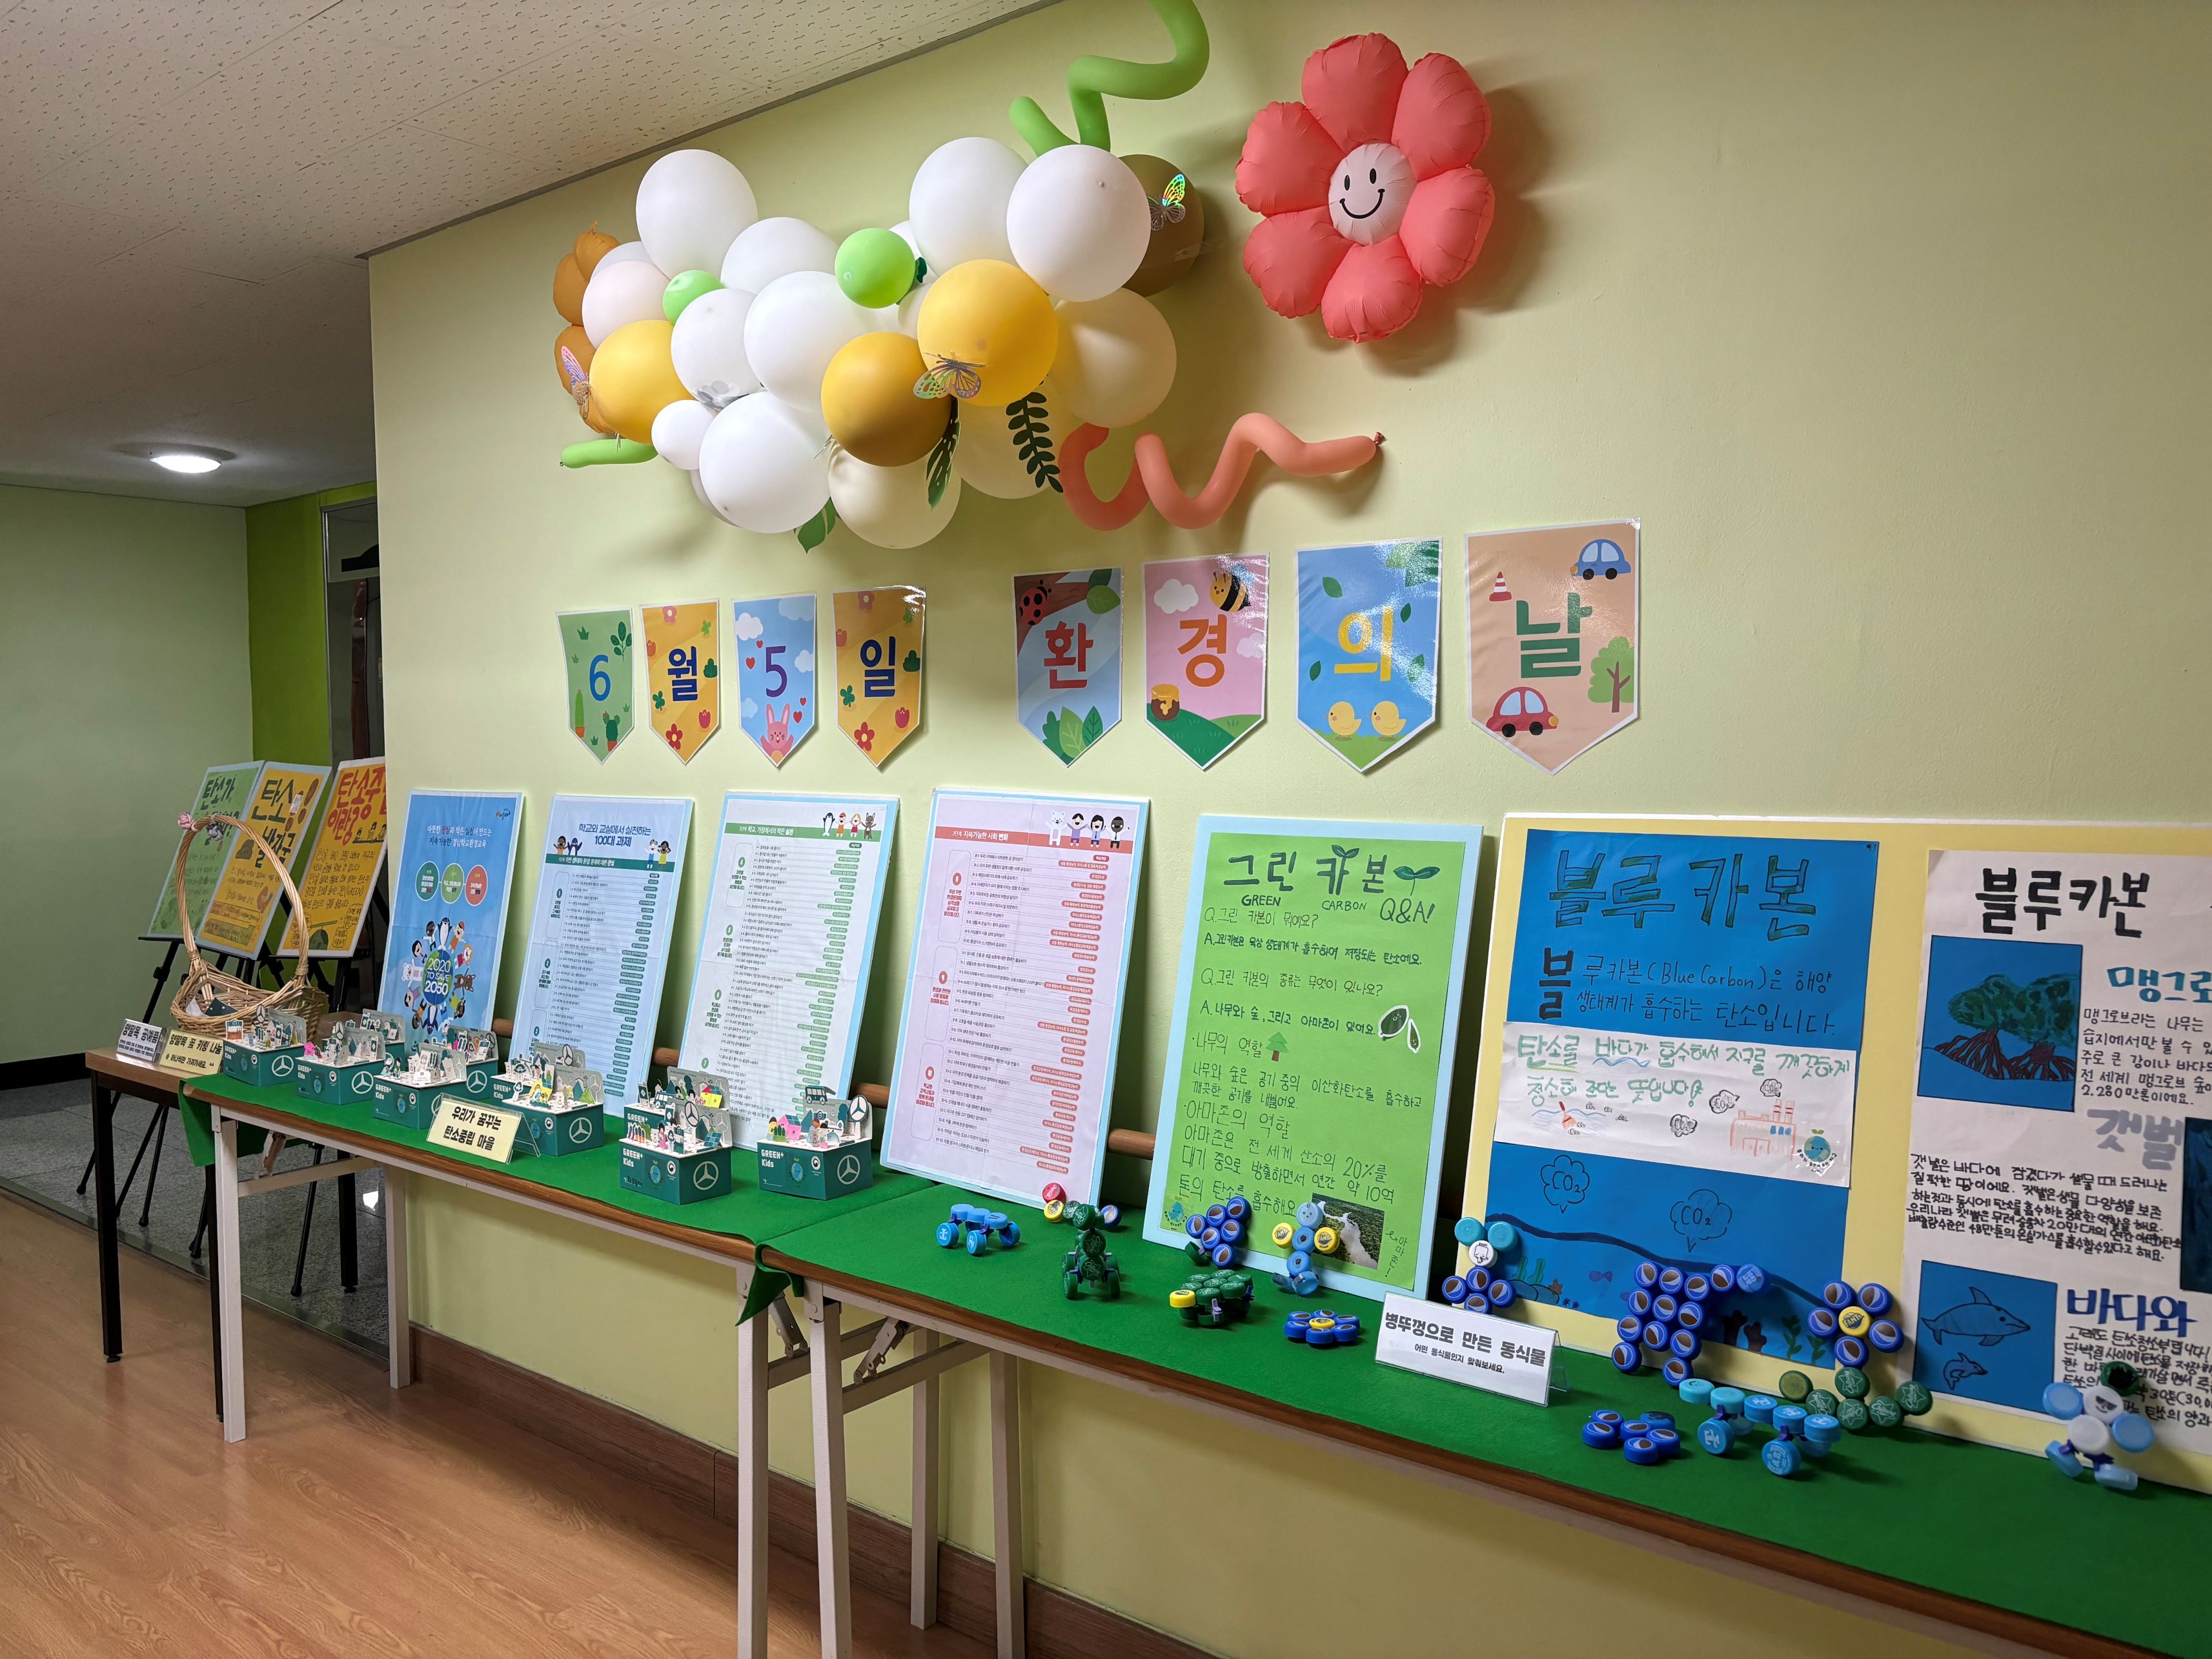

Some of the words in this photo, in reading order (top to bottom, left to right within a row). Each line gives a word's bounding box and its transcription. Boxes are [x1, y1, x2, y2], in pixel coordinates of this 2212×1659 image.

[1516, 593, 1593, 678] 날
[251, 779, 294, 824] 탄소
[337, 766, 387, 820] 탄소중
[579, 823, 598, 833] 학교와
[599, 825, 624, 835] 교실에서
[625, 826, 651, 835] 실천하는
[595, 835, 615, 846] 100대
[616, 837, 632, 847] 과제
[1224, 851, 1297, 891] 그린
[1316, 846, 1388, 895] 카본
[1241, 895, 1281, 906] GREEN
[1322, 901, 1367, 911] CARBON
[1380, 898, 1435, 924] Q&A!
[1248, 911, 1275, 926] 카본이
[1250, 937, 1263, 948] 육상
[1266, 939, 1299, 952] 생태계가
[1302, 942, 1338, 960] 흡수하여
[1345, 948, 1376, 962] 저장되는
[427, 958, 451, 973] 2020
[436, 973, 449, 981] SAVE
[425, 981, 448, 995] 2050
[1243, 971, 1268, 988] 카본의
[1280, 973, 1301, 988] 종류는
[1309, 975, 1337, 991] 무엇이
[1344, 981, 1383, 996] 있나요?
[1796, 971, 1832, 993] 해양
[1577, 989, 1634, 1013] 생태계가
[1641, 993, 1703, 1022] 흡수하는
[1717, 1003, 1835, 1035] 탄소입니다.
[2084, 1009, 2155, 1028] 맹그로브라는
[2167, 1017, 2203, 1032] 나무는
[1301, 1015, 1339, 1030] 아마존이
[1346, 1021, 1375, 1035] 있어요.
[196, 1040, 210, 1052] 키링
[210, 1043, 222, 1055] 나눔
[1239, 1038, 1263, 1058] 역할
[1517, 1034, 1580, 1068] 탄소를
[1596, 1037, 1648, 1057] 바다가
[1658, 1041, 1719, 1068] 흡수해서
[1725, 1047, 1766, 1077] 지구를
[1776, 1053, 1850, 1079] 깨끗하게
[2162, 1037, 2172, 1054] 볼
[2181, 1041, 2192, 1053] 수
[2081, 1050, 2105, 1065] 주로
[2111, 1052, 2121, 1066] 큰
[2130, 1055, 2171, 1068] 강이나
[1193, 1061, 1221, 1081] 나무와
[1230, 1066, 1247, 1084] 숲은
[1259, 1072, 1275, 1087] 공기
[1280, 1074, 1300, 1092] 중의
[1312, 1079, 1374, 1102] 이산화탄소를
[1386, 1090, 1421, 1108] 흡수하고
[2081, 1069, 2093, 1082] 전
[2100, 1072, 2129, 1084] 세계
[2139, 1074, 2185, 1088] 맹그로브
[376, 1092, 384, 1100] Kids
[1193, 1081, 1221, 1097] 깨끗한
[1229, 1087, 1252, 1104] 공기를
[1261, 1093, 1298, 1109] 내뿜어요.
[1527, 1075, 1577, 1107] 청소해
[452, 1106, 476, 1123] 우리가
[477, 1113, 502, 1130] 꿈꾸는
[1259, 1114, 1290, 1139] 역할
[443, 1125, 476, 1146] 탄소중립
[477, 1135, 495, 1151] 마을
[2087, 1109, 2184, 1171] 갯벌
[623, 1158, 634, 1167] Kids
[762, 1159, 774, 1168] Kids
[1185, 1124, 1233, 1149] 아마존은
[1249, 1139, 1259, 1154] 전
[1266, 1145, 1292, 1161] 세계
[1301, 1149, 1335, 1171] 산소의
[1343, 1157, 1387, 1183] 20%를
[1182, 1145, 1206, 1170] 대기
[1214, 1152, 1241, 1174] 중으로
[1252, 1161, 1304, 1186] 방출하면서
[1312, 1175, 1335, 1189] 연간
[1348, 1180, 1360, 1197] 약
[1366, 1186, 1394, 1204] 10억
[1954, 1161, 2000, 1176] 바다에
[2098, 1176, 2116, 1186] 때
[2120, 1177, 2167, 1192] 드러나는
[1180, 1174, 1203, 1201] 톤의
[1906, 1203, 1953, 1216] 우리나라
[1956, 1195, 1991, 1209] 동시에
[1275, 1228, 1289, 1238] FANTA
[1843, 1314, 1865, 1327] FANTA
[2067, 1288, 2198, 1338] 바다와
[1385, 1312, 1454, 1343] 병뚜껑으로
[1462, 1331, 1492, 1353] 만든
[1500, 1341, 1546, 1367] 동식물
[1415, 1343, 1428, 1354] 어떤
[1431, 1348, 1464, 1363] 동식물인지
[1467, 1357, 1505, 1374] 맞춰보세요.
